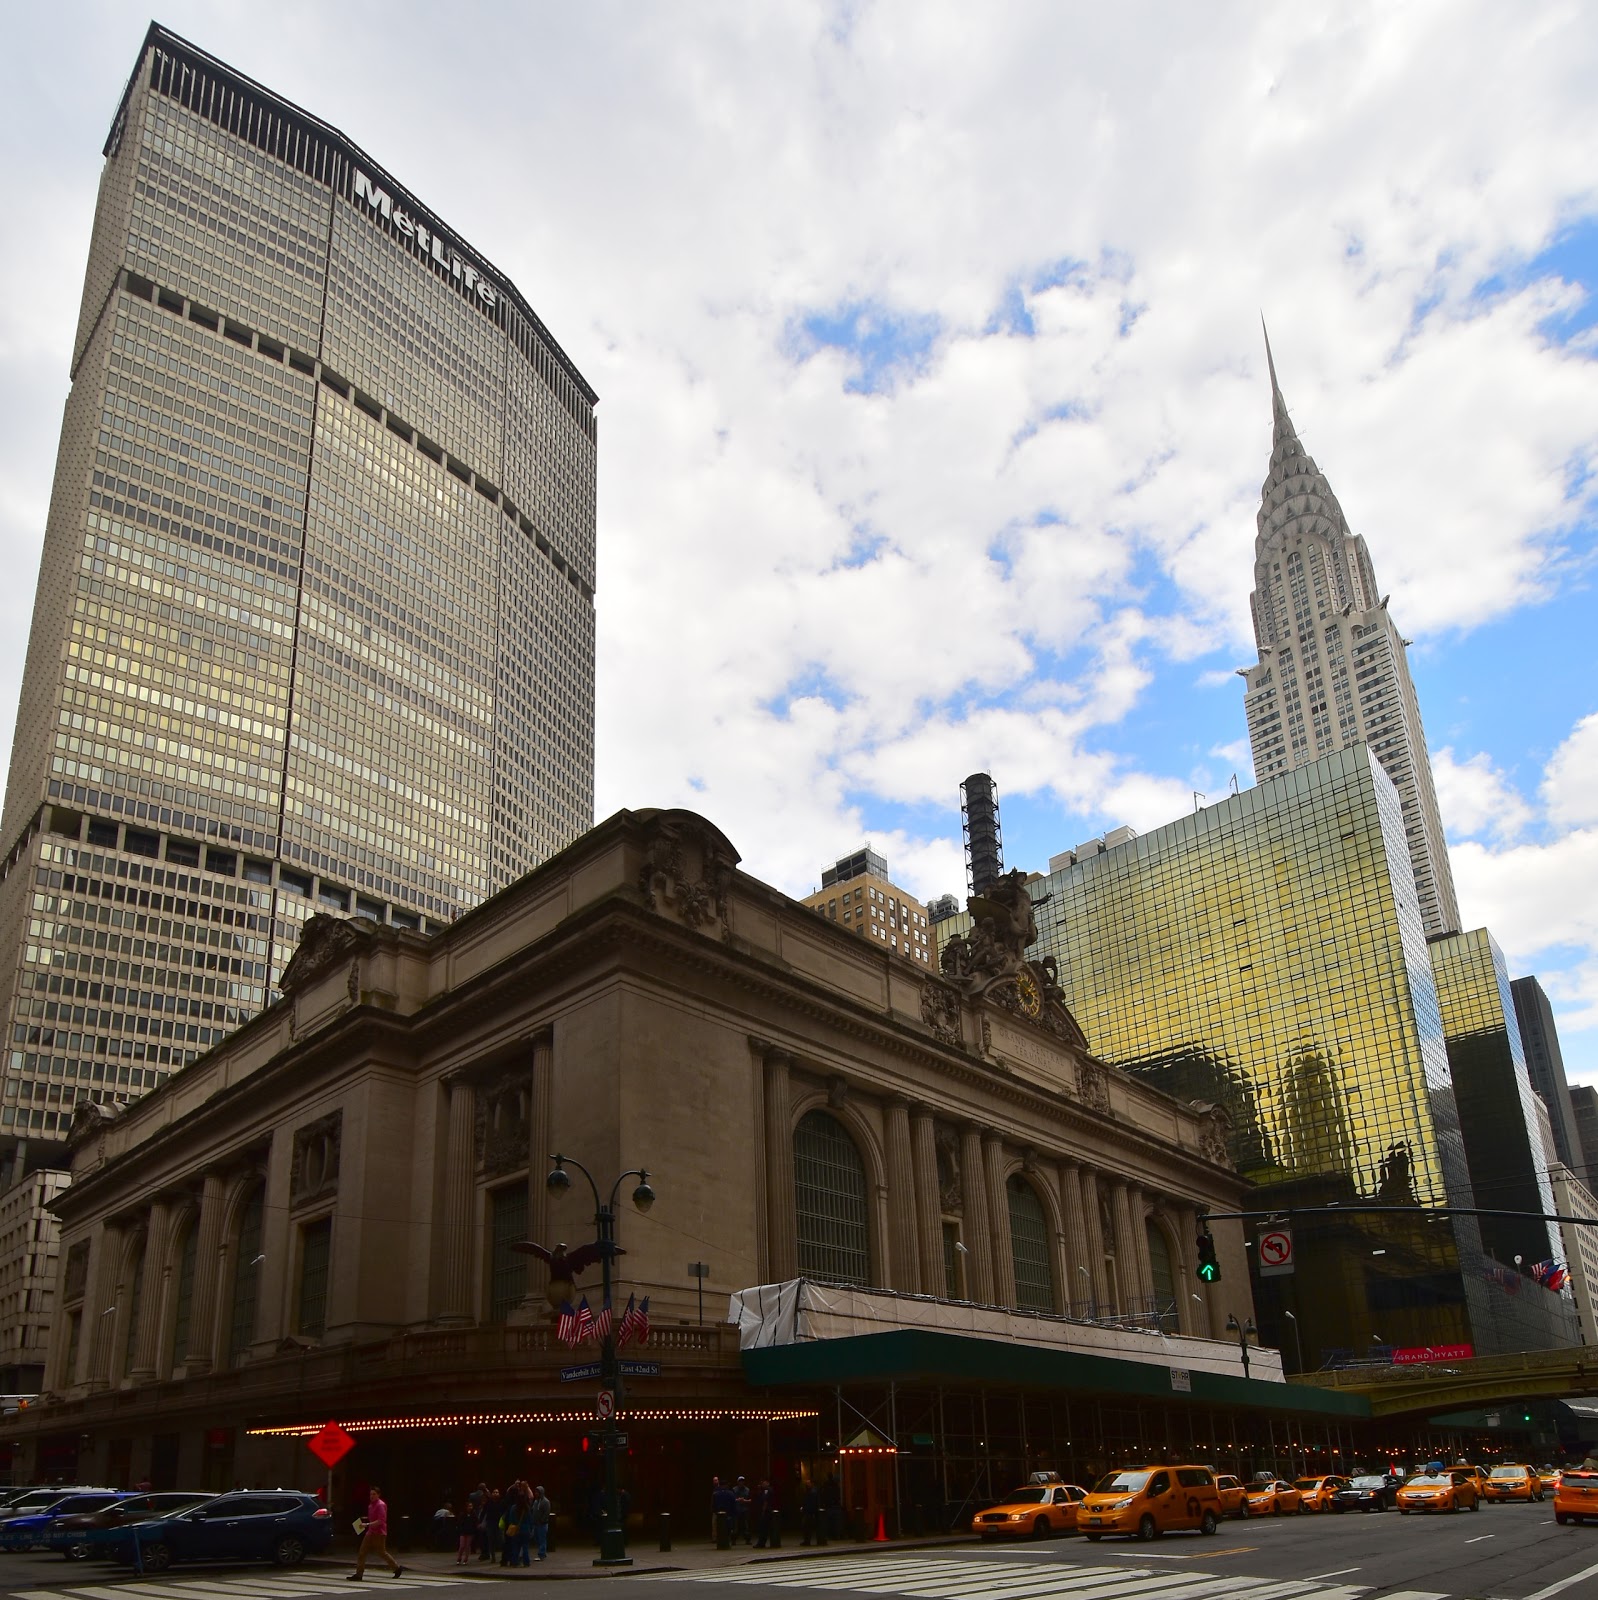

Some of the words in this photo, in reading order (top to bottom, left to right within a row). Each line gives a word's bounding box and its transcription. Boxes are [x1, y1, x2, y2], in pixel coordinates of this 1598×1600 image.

[354, 169, 496, 307] MetLife
[999, 1027, 1027, 1047] GRAND
[1030, 1043, 1065, 1067] CENTRAL
[1014, 1044, 1052, 1070] TERMINAL
[1398, 1353, 1429, 1361] GRAND
[1434, 1350, 1465, 1358] HYATT
[561, 1369, 590, 1380] Vanderbilt
[590, 1366, 601, 1375] Ave
[620, 1364, 634, 1373] East
[634, 1365, 650, 1374] 42nd
[651, 1366, 658, 1374] St
